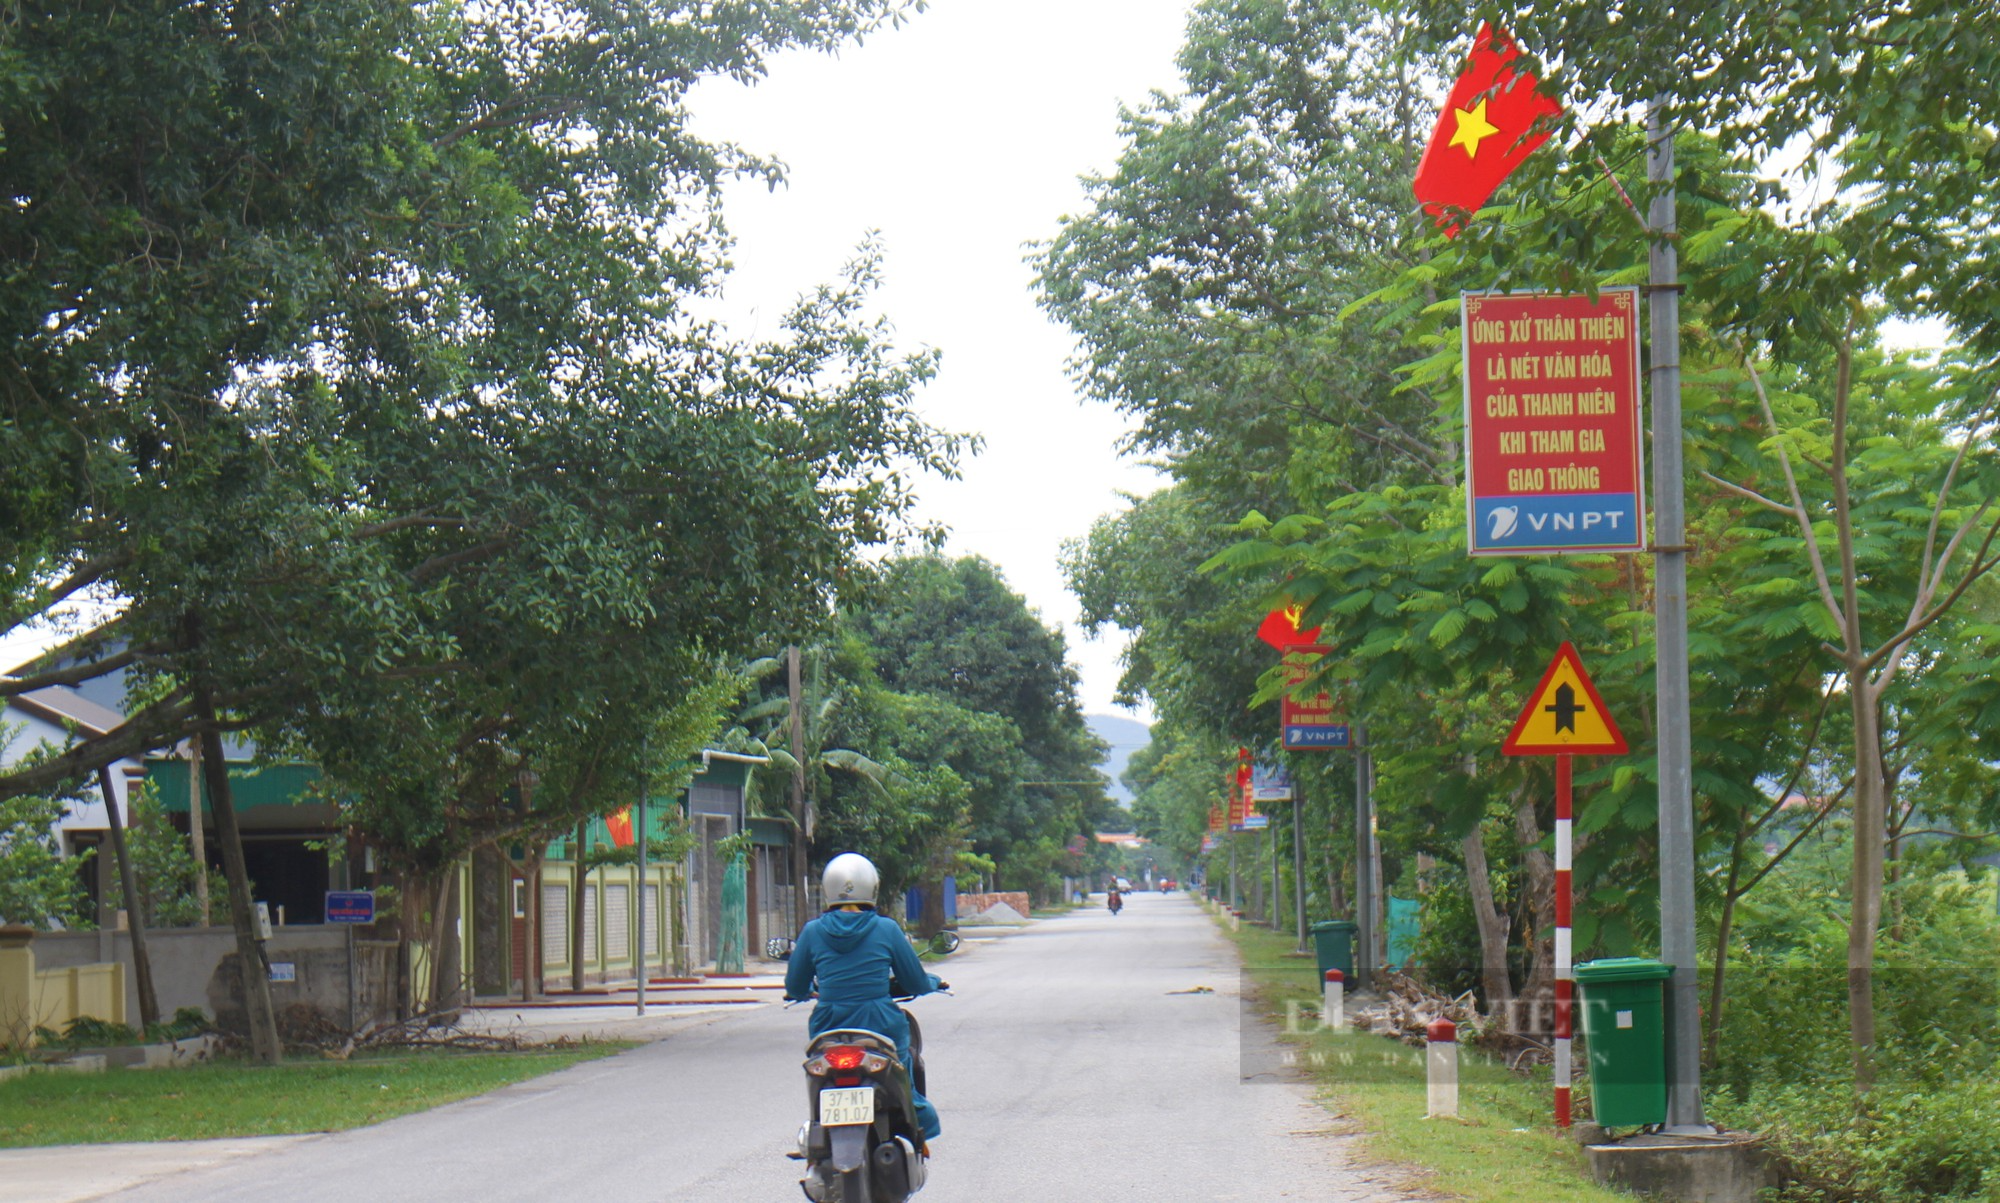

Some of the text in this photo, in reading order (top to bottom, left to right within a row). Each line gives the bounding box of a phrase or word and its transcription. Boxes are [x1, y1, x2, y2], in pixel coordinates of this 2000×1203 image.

[1472, 312, 1625, 344] ỨNG XỬ THÂN THIỆN
[1487, 351, 1612, 380] LÀ NÉT VĂN HÓA
[1487, 387, 1616, 417] CỦA THANH NIÊN
[1500, 429, 1606, 454] KHI THAM GIA
[1508, 462, 1600, 492] GIAO THÔNG
[1528, 511, 1624, 531] VNPT
[1306, 732, 1344, 740] VNPT
[825, 1106, 869, 1123] 781.07
